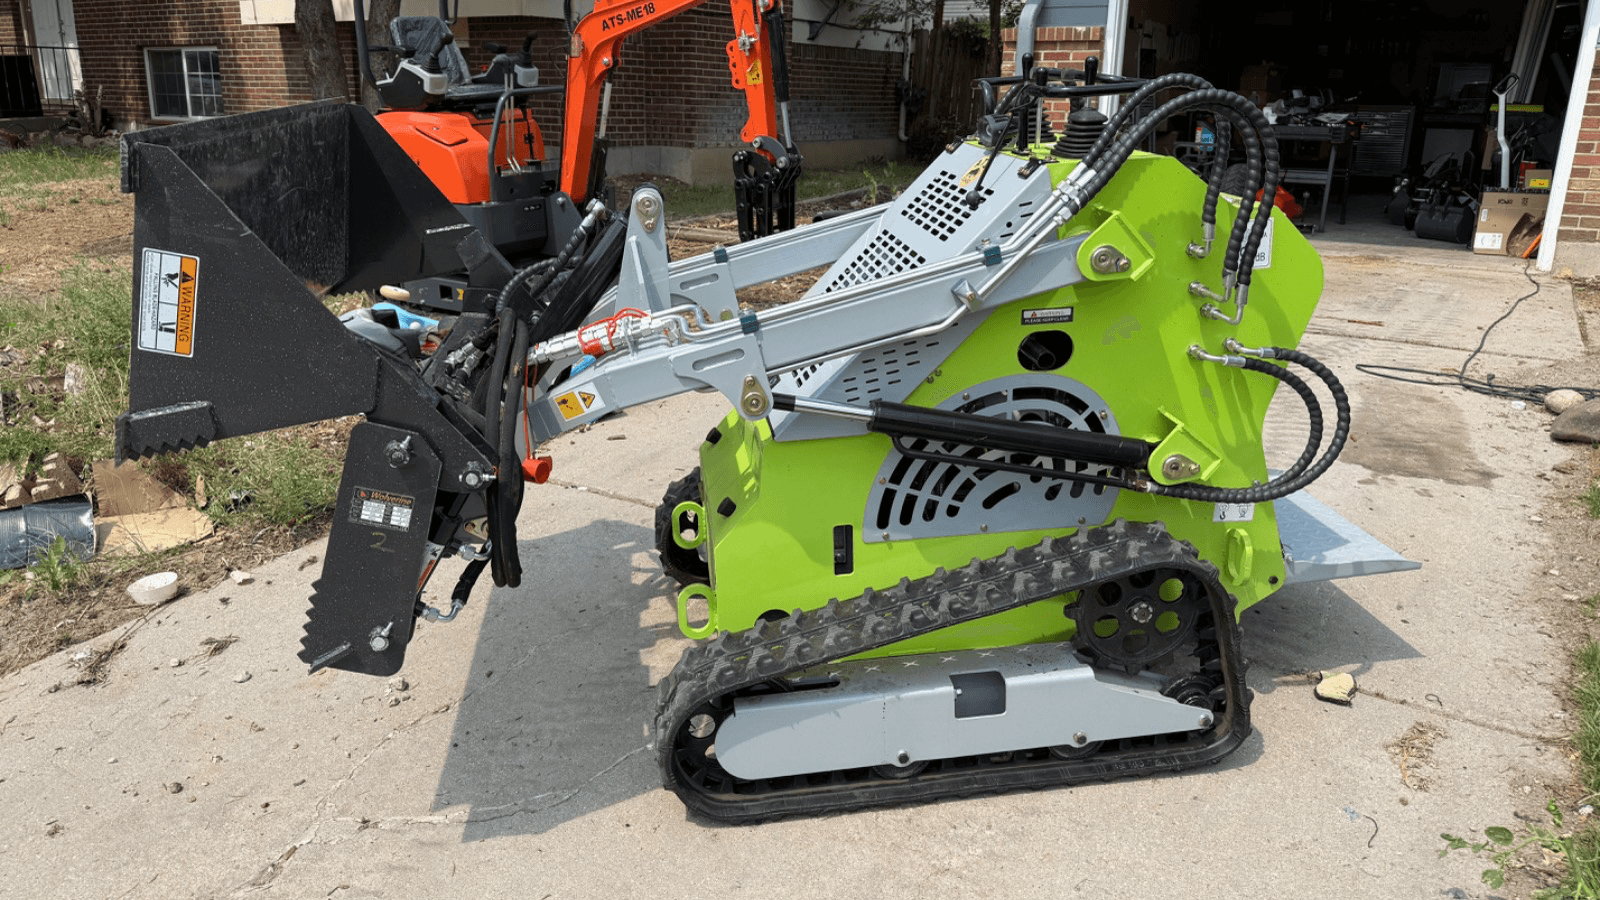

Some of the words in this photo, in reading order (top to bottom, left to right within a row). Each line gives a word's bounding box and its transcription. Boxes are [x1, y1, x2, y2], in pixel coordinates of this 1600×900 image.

[602, 2, 656, 31] ATS-ME18
[179, 286, 192, 342] WARNING
[370, 491, 412, 505] Wolverine
[370, 531, 395, 553] 2
